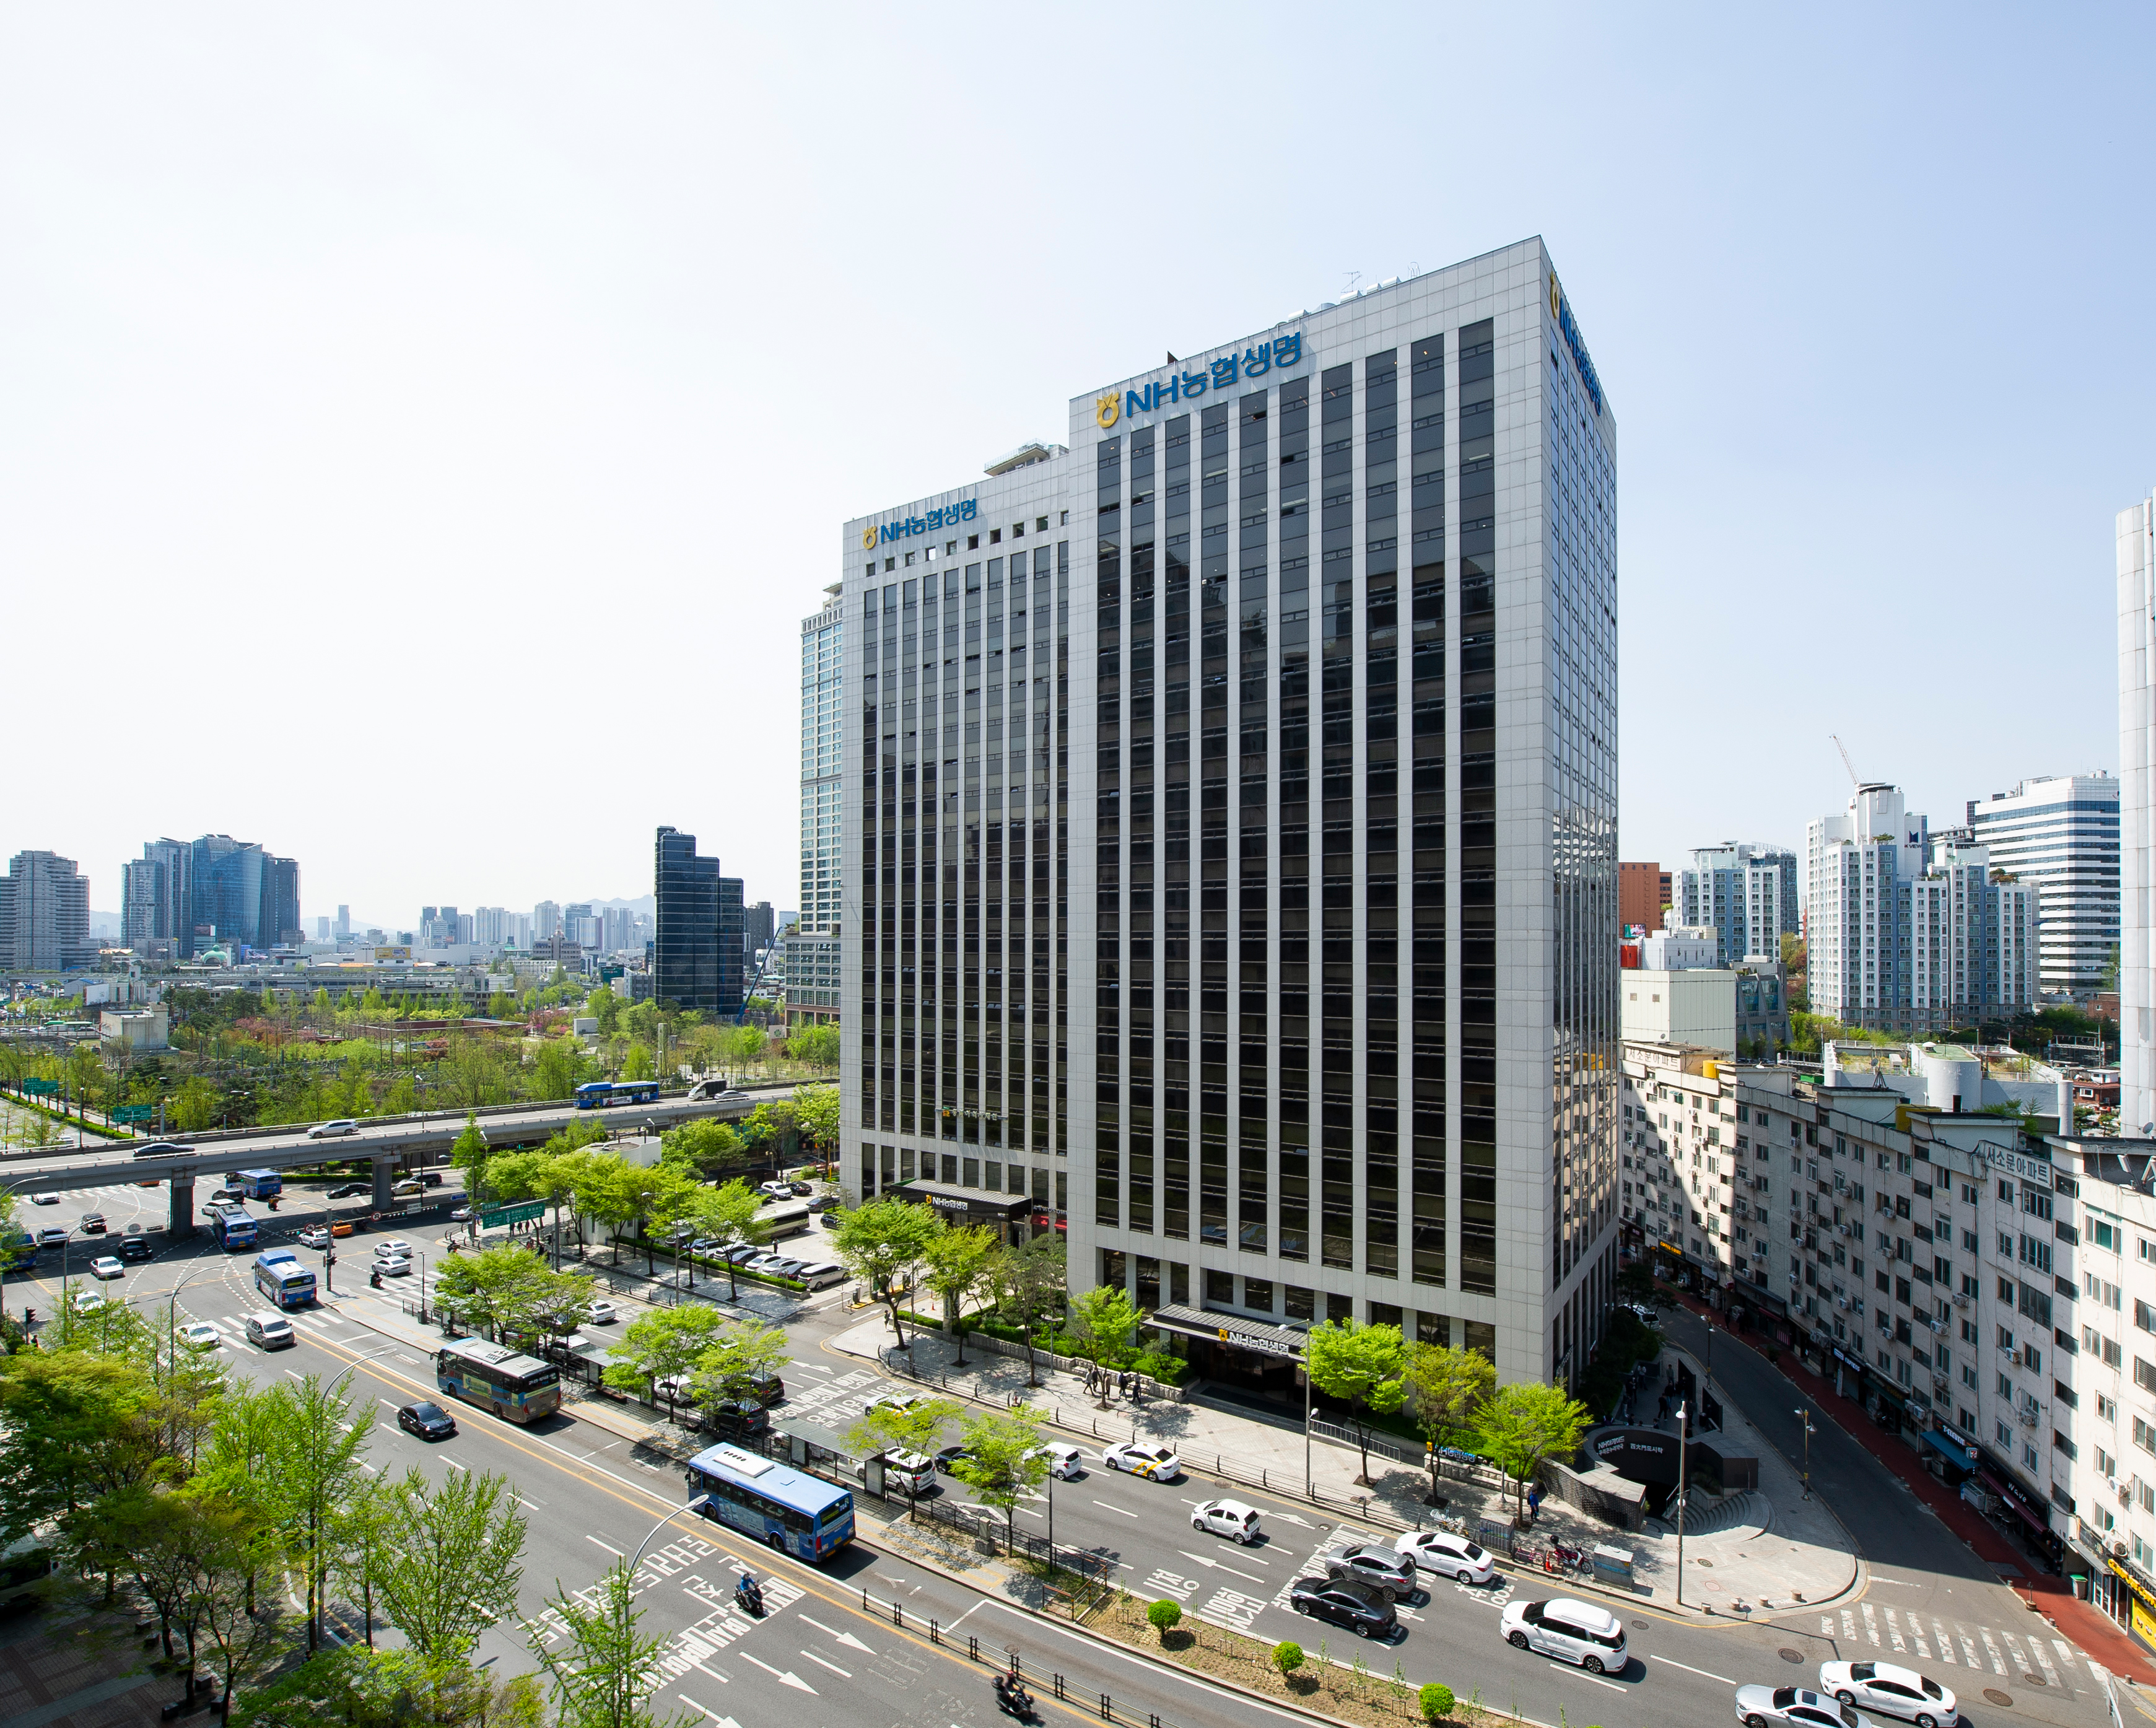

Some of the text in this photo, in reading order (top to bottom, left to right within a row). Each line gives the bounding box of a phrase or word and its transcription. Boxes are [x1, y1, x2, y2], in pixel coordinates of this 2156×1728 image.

[1126, 331, 1301, 417] NH농협생명
[880, 498, 977, 543] NH농협생명
[1629, 1048, 1678, 1067] 서소문아파트
[1986, 1146, 2048, 1184] 서소문아파트
[932, 1196, 968, 1210] NH농협생명
[1229, 1332, 1290, 1356] NH농협생명
[839, 1502, 847, 1512] 704
[2007, 1481, 2027, 1503] Wave
[771, 1521, 779, 1529] 704
[639, 1533, 718, 1577] 로터리
[679, 1553, 762, 1600] 신촌
[1143, 1568, 1200, 1602] 시청
[1200, 1586, 1268, 1630] 시의회
